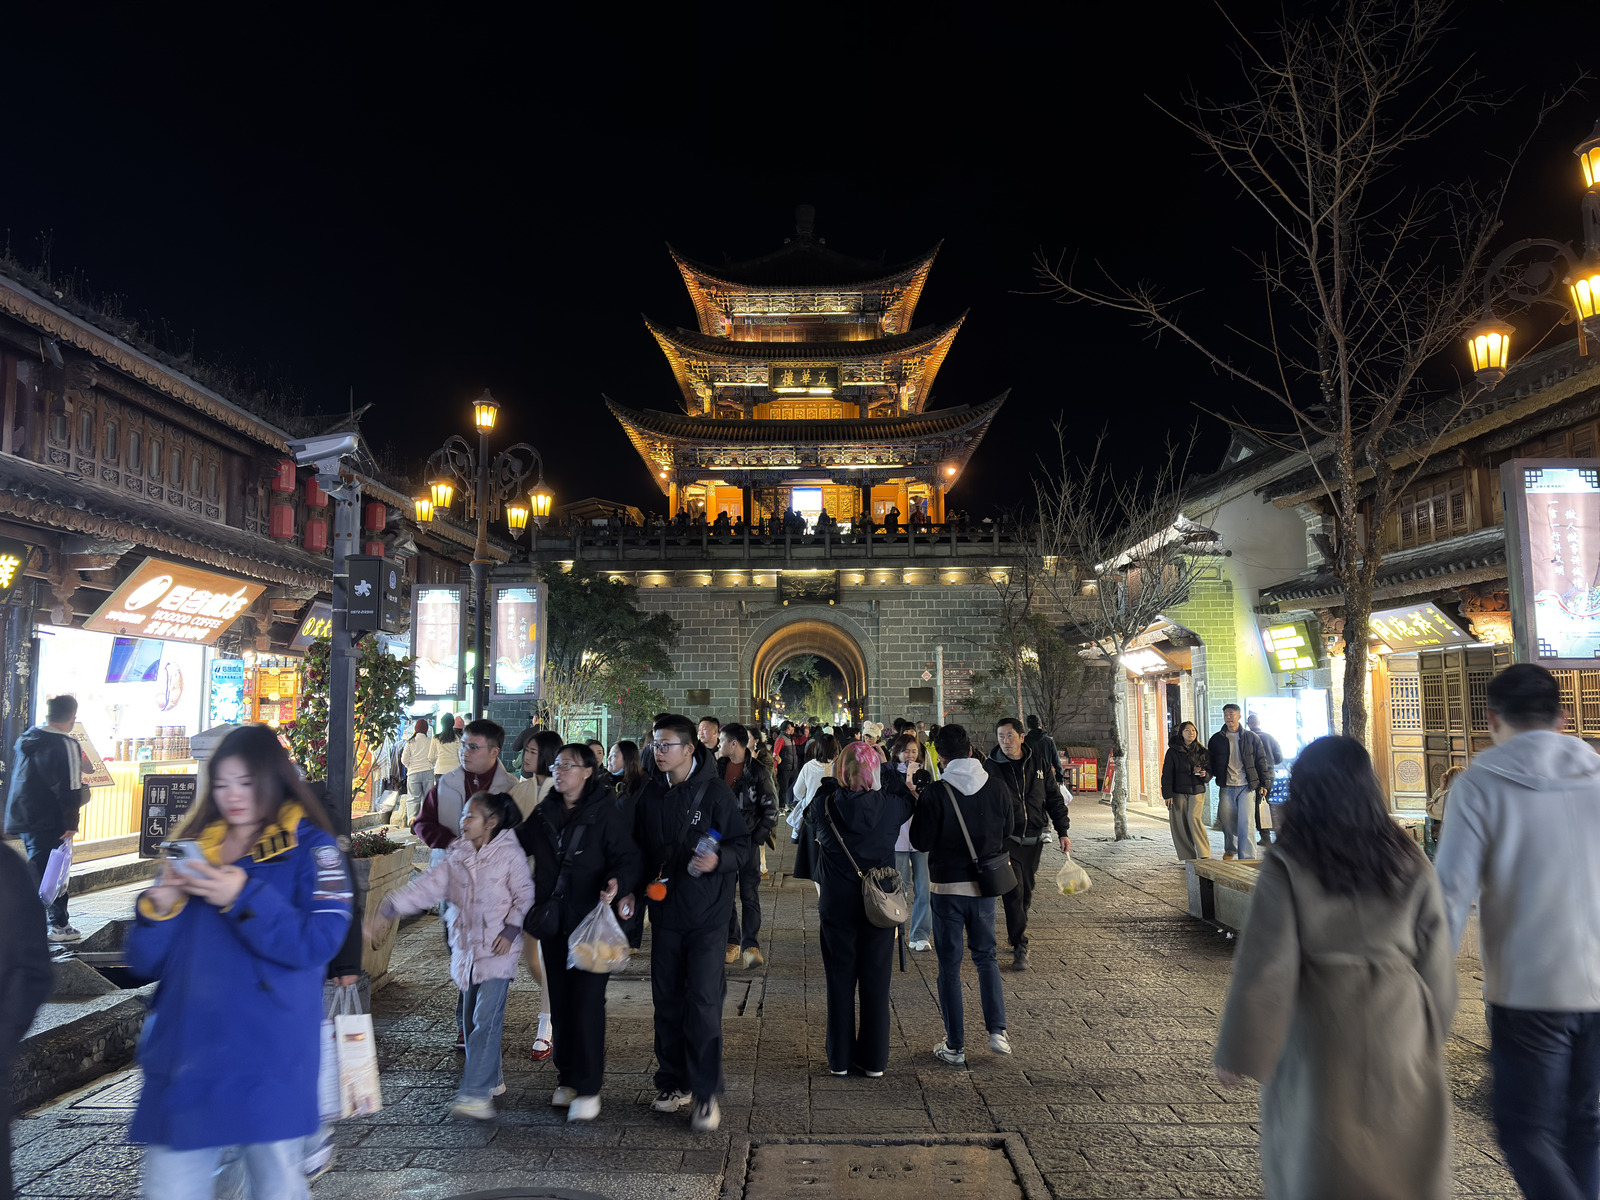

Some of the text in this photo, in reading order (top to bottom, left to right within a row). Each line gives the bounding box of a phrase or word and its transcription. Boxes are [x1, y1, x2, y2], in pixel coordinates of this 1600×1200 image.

[151, 610, 190, 625] HOGOOD
[190, 616, 224, 629] COFFEE
[171, 783, 195, 791] 卫生间
